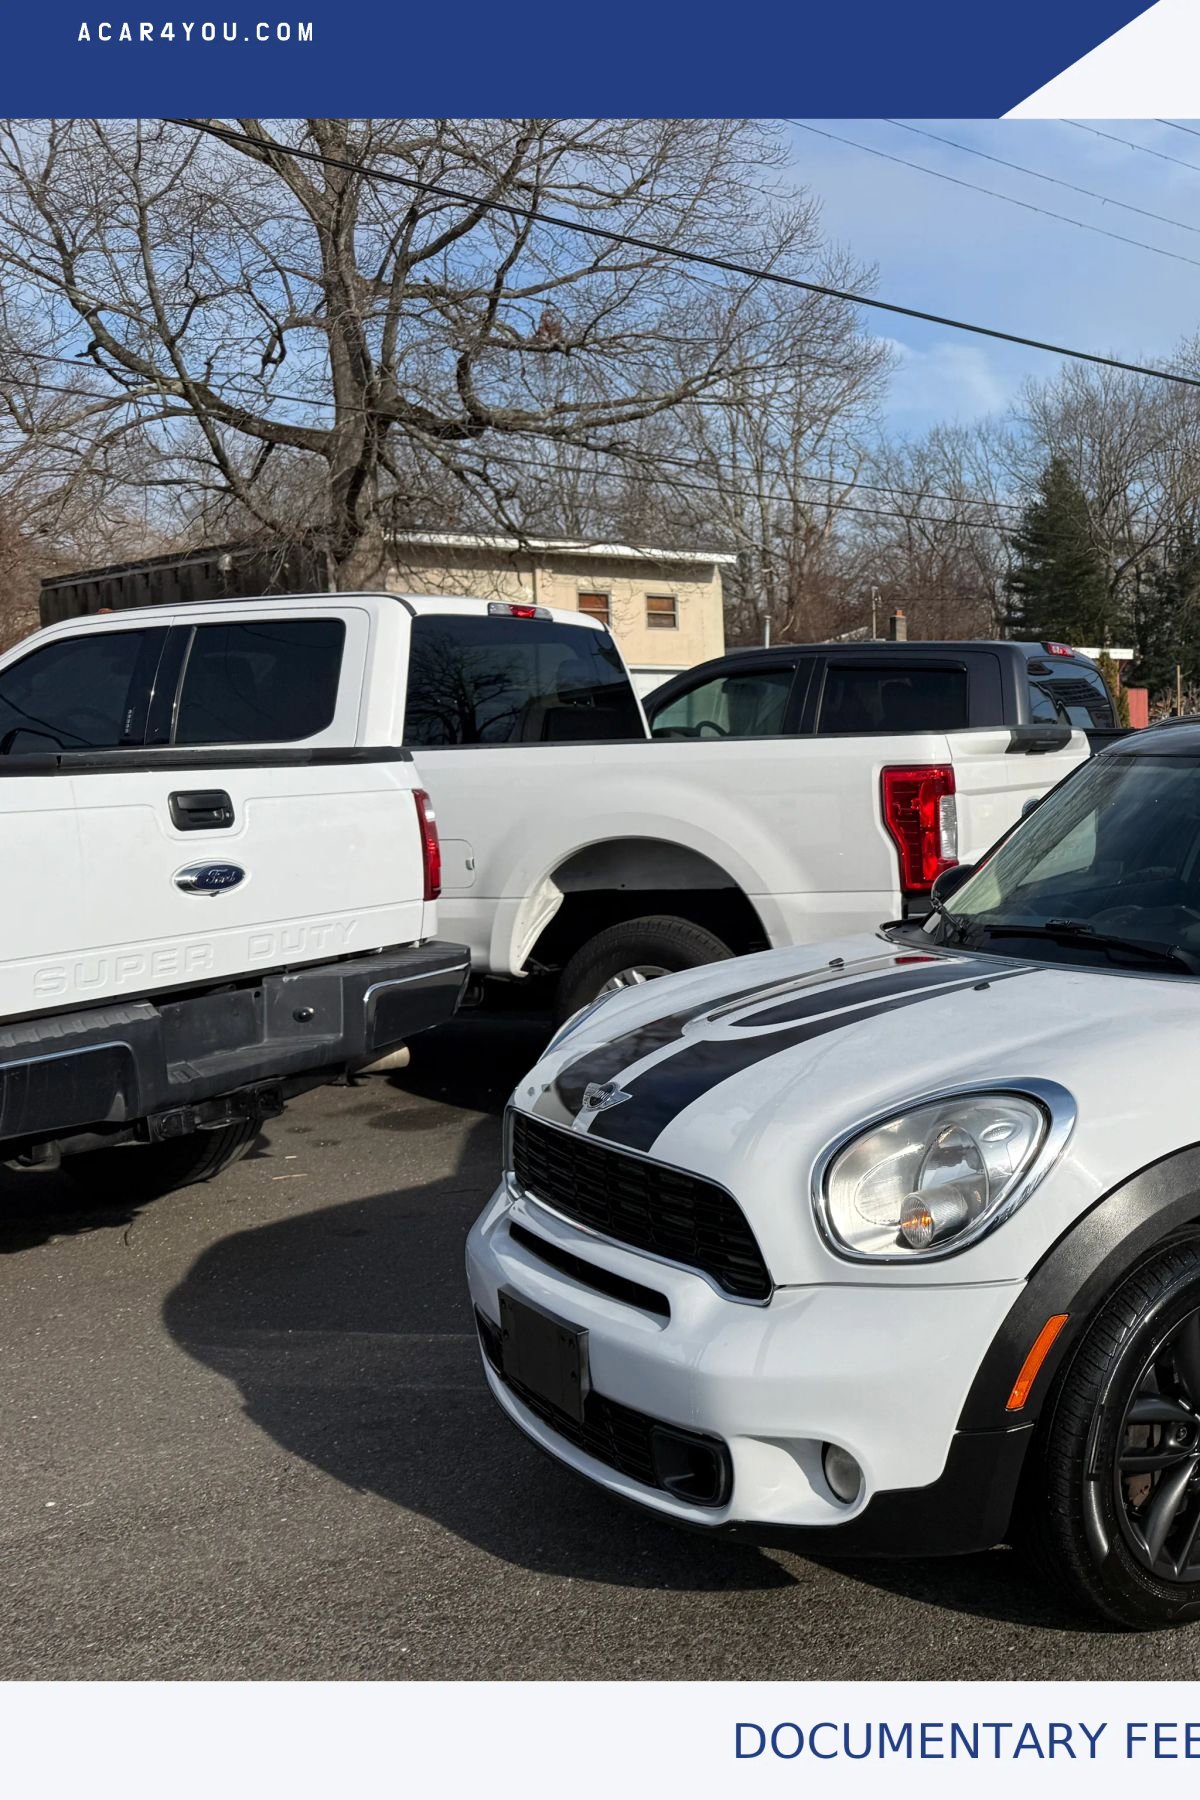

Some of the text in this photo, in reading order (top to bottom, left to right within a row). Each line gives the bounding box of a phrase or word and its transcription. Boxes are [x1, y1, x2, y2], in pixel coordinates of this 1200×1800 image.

[206, 868, 237, 884] Ford
[33, 920, 358, 998] SUPER DUTY
